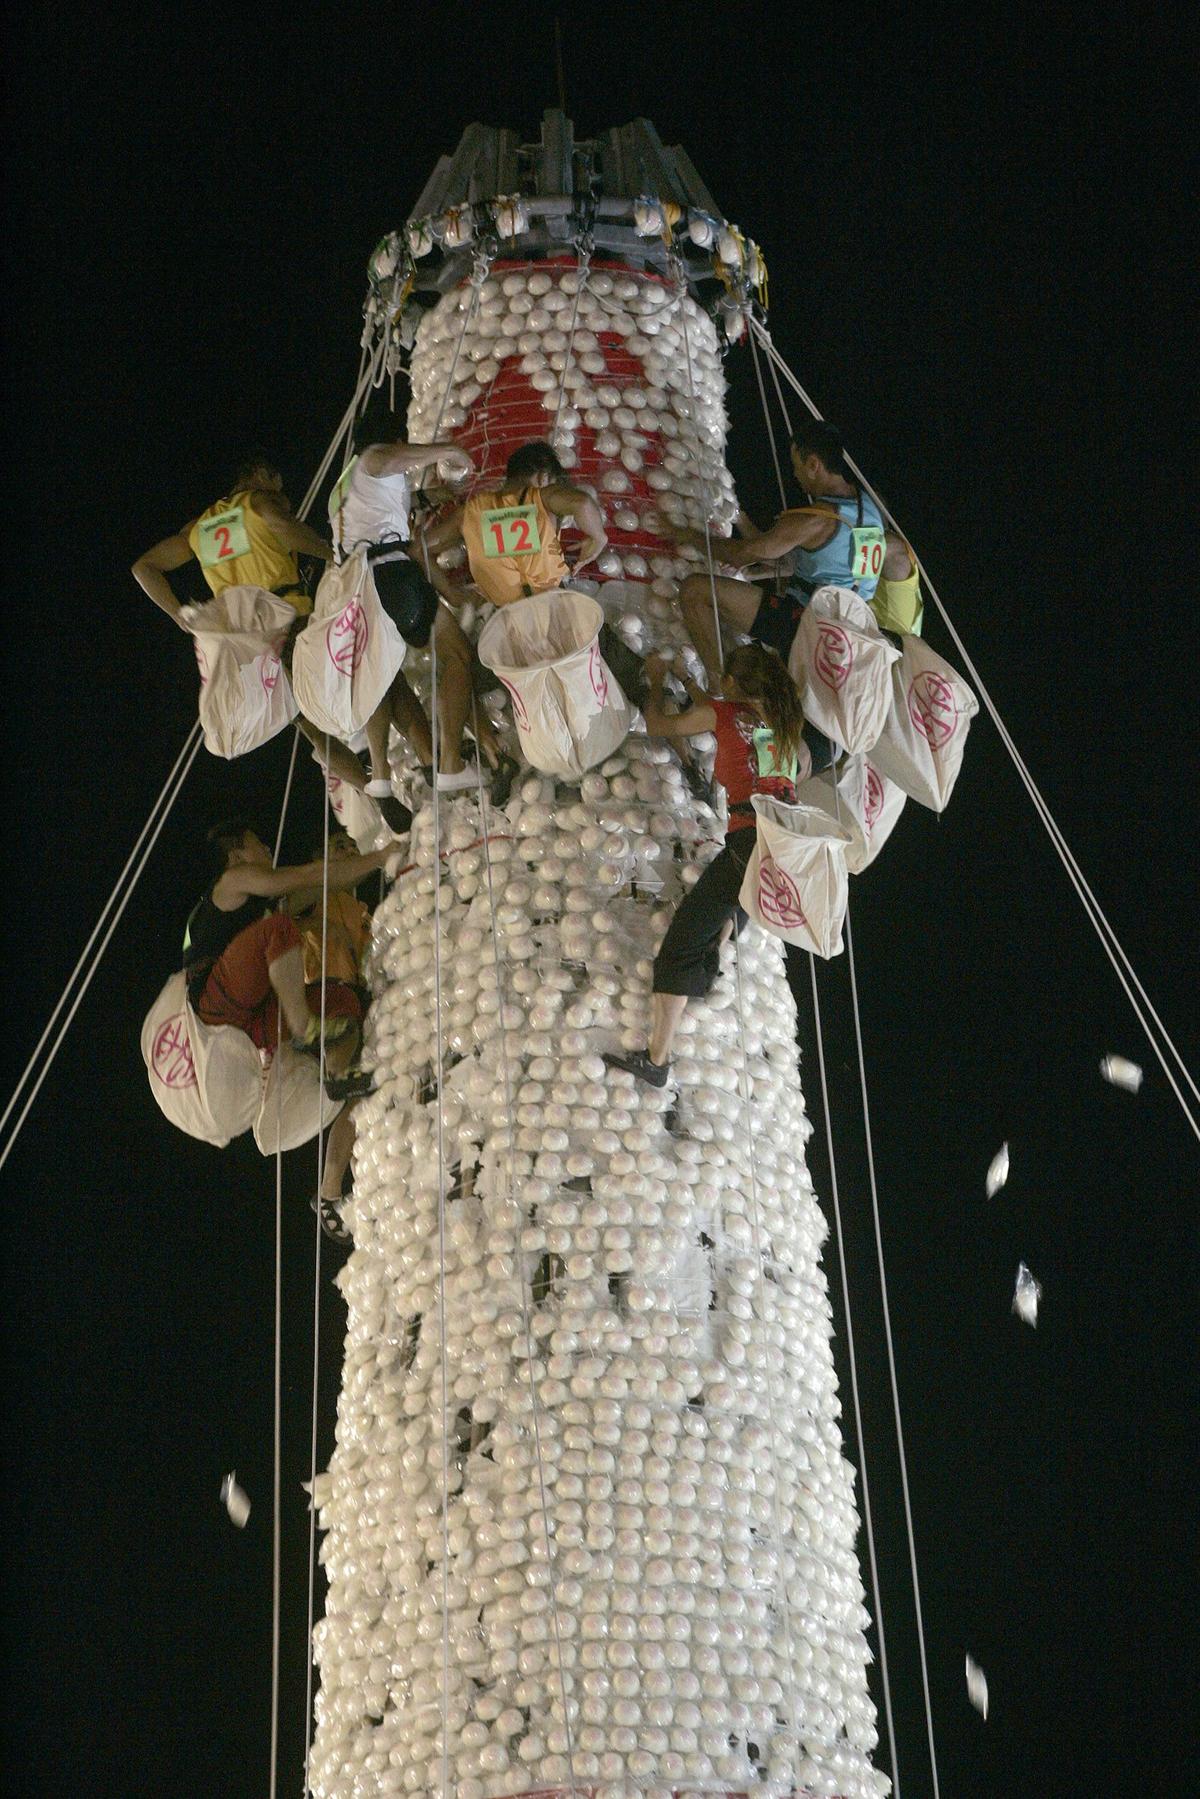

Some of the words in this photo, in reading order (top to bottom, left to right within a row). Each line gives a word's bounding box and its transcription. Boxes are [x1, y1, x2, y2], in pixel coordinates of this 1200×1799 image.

[214, 527, 236, 559] 2
[490, 519, 533, 554] 12
[860, 543, 883, 576] 10
